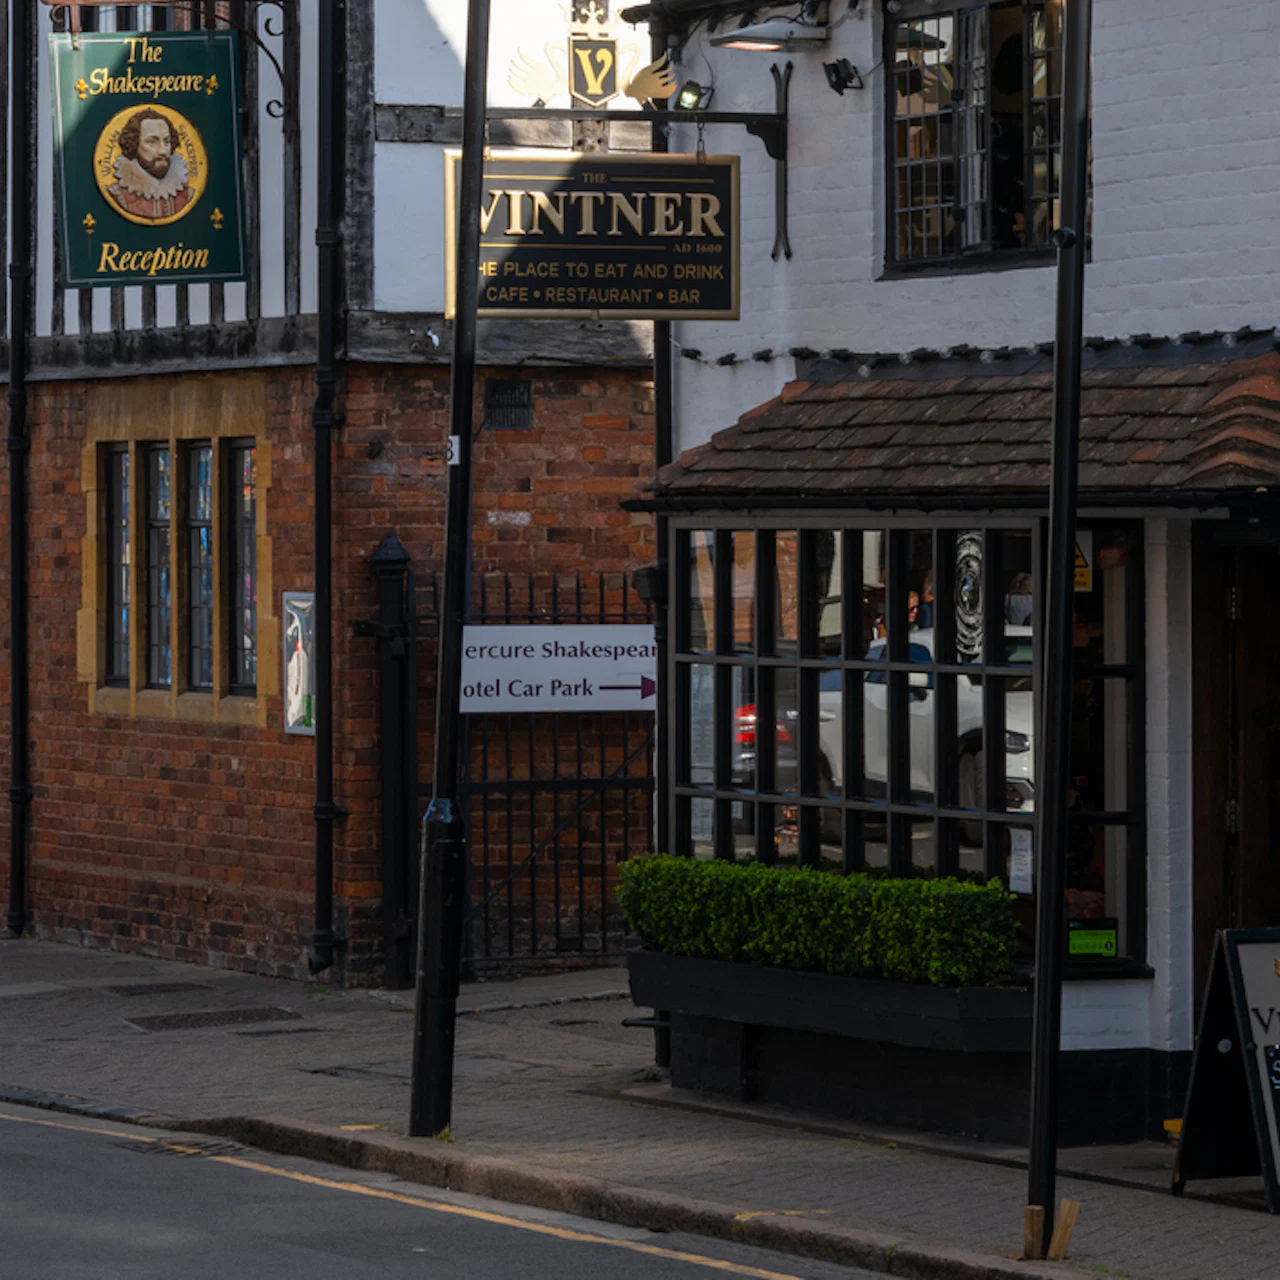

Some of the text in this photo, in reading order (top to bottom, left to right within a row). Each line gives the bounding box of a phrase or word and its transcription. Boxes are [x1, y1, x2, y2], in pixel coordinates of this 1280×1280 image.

[124, 36, 164, 63] The
[88, 66, 205, 99] Shakespeare
[581, 172, 608, 184] THE
[97, 241, 210, 276] Reception
[672, 244, 692, 254] AD
[478, 261, 724, 280] HE PLACE TO EAT AND DRINK
[485, 285, 701, 304] CAFE RESTAURANT BAR
[464, 640, 657, 661] ercure Shakespear
[462, 677, 594, 698] otel Car Park
